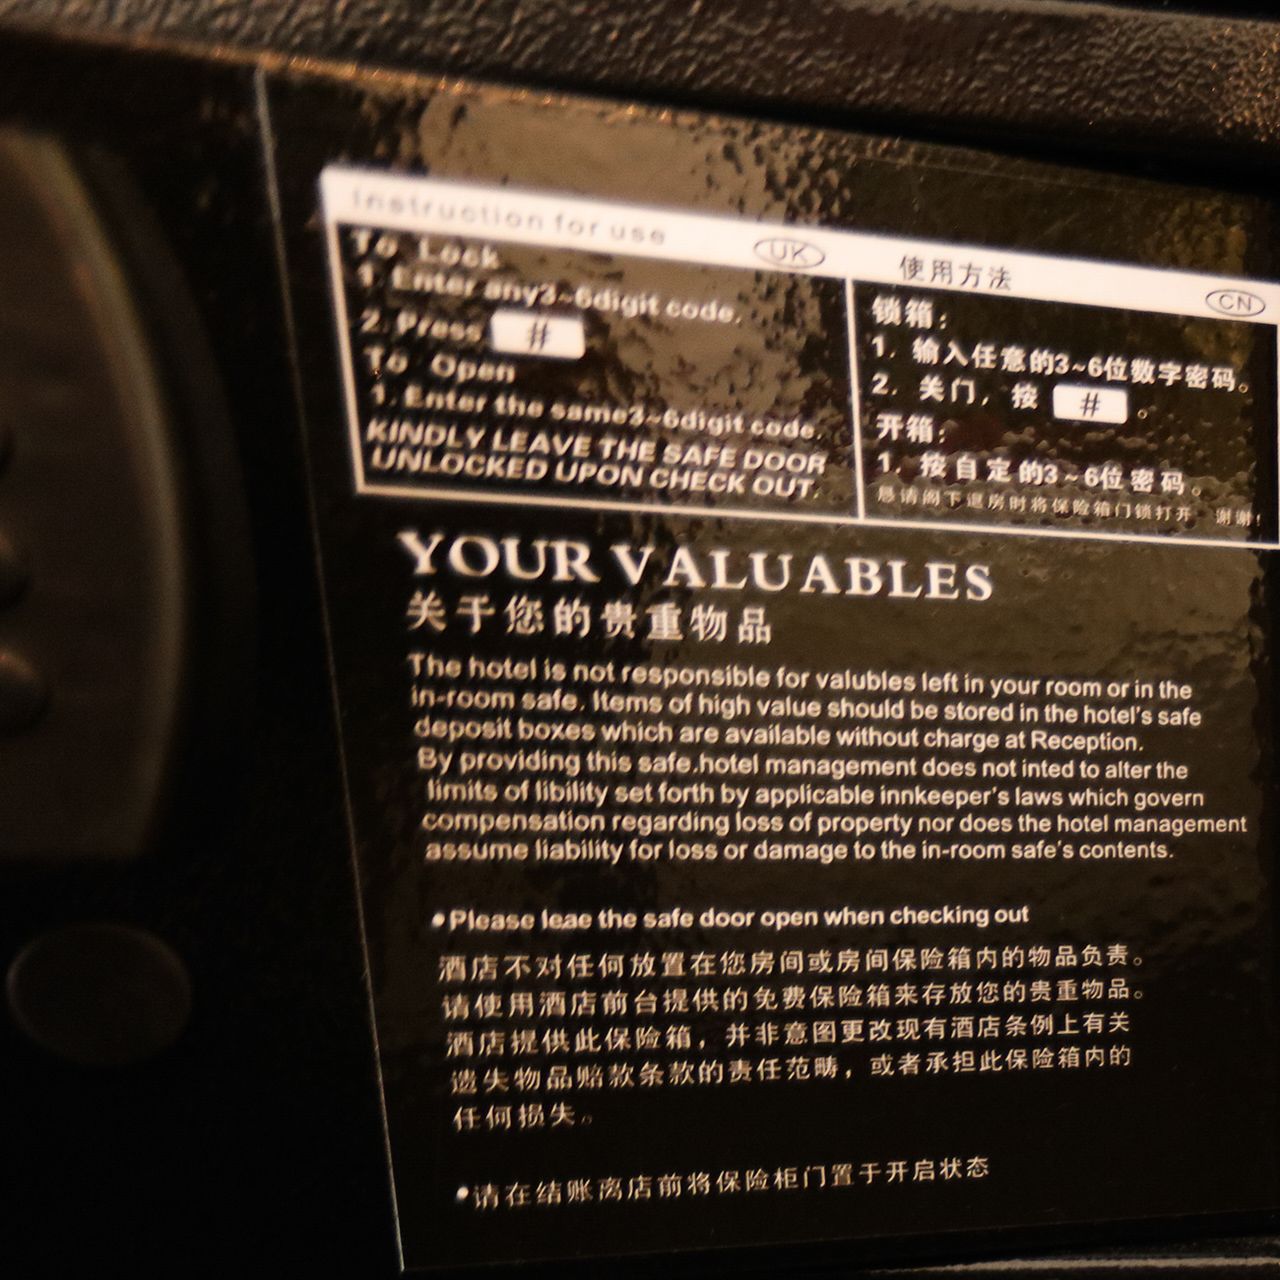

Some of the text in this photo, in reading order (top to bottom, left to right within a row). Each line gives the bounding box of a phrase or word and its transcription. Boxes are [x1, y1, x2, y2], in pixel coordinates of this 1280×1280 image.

[352, 188, 666, 245] Instruction for use
[416, 236, 500, 269] Lock
[769, 241, 808, 264] UK
[898, 254, 1013, 291] 使用方法
[391, 264, 477, 297] Enter
[665, 300, 742, 324] code.
[1217, 294, 1253, 312] CN
[396, 309, 482, 342] Press
[363, 345, 516, 384] To Open
[404, 384, 487, 413] Enter
[493, 392, 545, 418] the
[750, 418, 823, 441] code.
[366, 416, 829, 476] KINDLY LEAVE THE SAFE DOOR
[371, 445, 549, 481] UNLOCKED
[555, 460, 645, 488] UPON
[649, 467, 747, 494] CHECK
[397, 533, 994, 601] YOUR VALUABLES
[406, 590, 773, 645] 关于您的贵重物品
[408, 653, 1193, 700] The hotel is not responsible for valubles left in your room or in the
[411, 689, 515, 709] in-room
[521, 688, 585, 711] safe.
[592, 690, 663, 714] Items
[668, 692, 693, 714] of
[698, 693, 751, 720] high
[756, 696, 822, 717] value
[827, 697, 905, 720] should
[910, 699, 939, 720] be
[944, 702, 1014, 722] stored
[1019, 703, 1039, 723] in
[1044, 703, 1079, 724] the
[1157, 707, 1202, 727] safe
[414, 716, 1144, 754] deposit boxes which are available without charge at Reception.
[417, 747, 453, 775] By
[459, 750, 581, 777] providing
[586, 750, 632, 772] this
[765, 758, 917, 780] management
[922, 757, 977, 777] does
[982, 759, 1017, 778] not
[1022, 759, 1074, 779] inted
[1079, 760, 1100, 779] to
[1105, 760, 1152, 779] alter
[1156, 761, 1188, 780] the
[427, 779, 498, 801] limits
[504, 779, 529, 802] of
[535, 780, 609, 808] libility
[614, 783, 653, 803] set
[657, 781, 715, 804] forth
[720, 783, 750, 809] by
[755, 784, 875, 808] applicable
[1015, 786, 1064, 806] laws
[1068, 787, 1129, 807] which
[1134, 792, 1204, 812] govern
[422, 811, 1248, 837] compensation regarding loss of property nor does the hotel management
[425, 843, 529, 860] assume
[535, 839, 624, 864] liability
[629, 838, 663, 860] for
[668, 839, 718, 860] loss
[723, 843, 749, 860] or
[753, 840, 848, 864] damage
[853, 841, 876, 860] to
[880, 839, 916, 860] the
[922, 844, 1006, 860] in-room
[1079, 841, 1174, 859] contents.
[449, 905, 1029, 931] Please leae the safe door open when checking out
[438, 943, 1145, 983] 酒店不对任何放置在您房间或房间保险箱内的物品负责。
[441, 977, 1145, 1021] 请使用酒店前台提供的免费保险箱来存放您的贵重物品。
